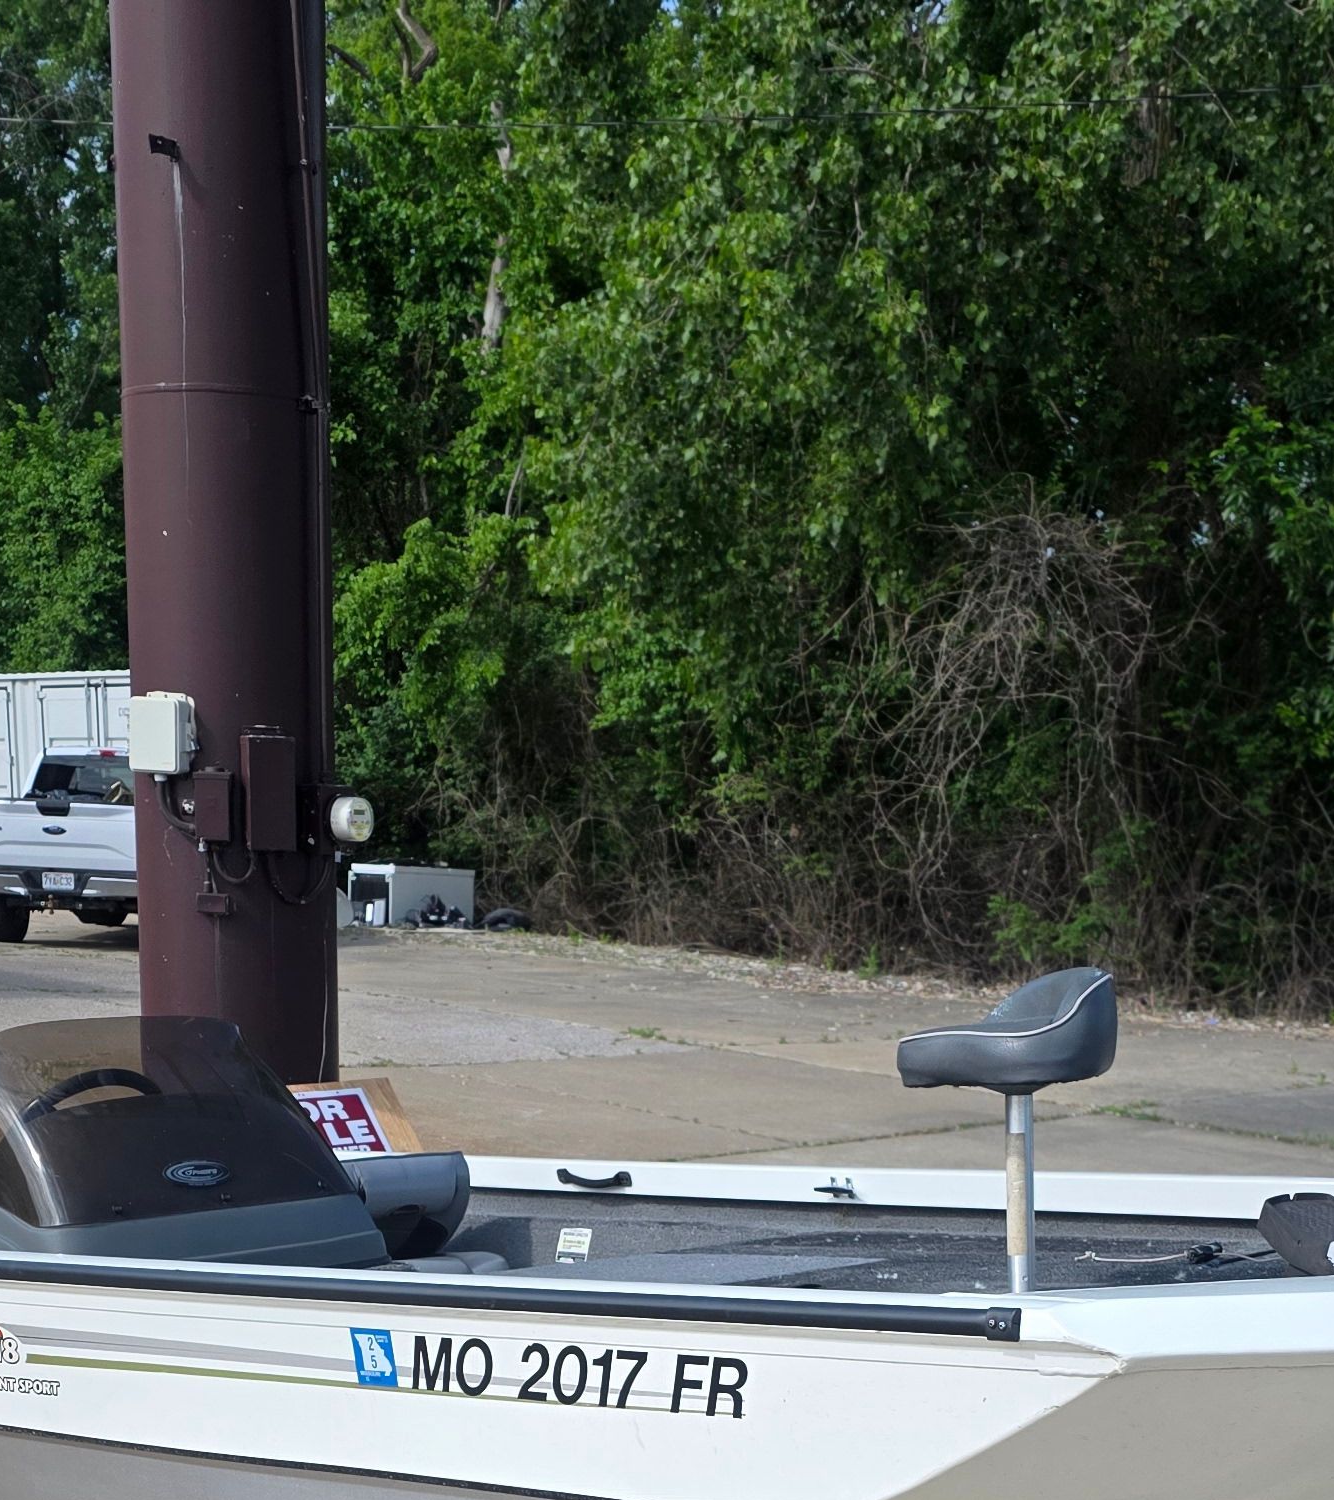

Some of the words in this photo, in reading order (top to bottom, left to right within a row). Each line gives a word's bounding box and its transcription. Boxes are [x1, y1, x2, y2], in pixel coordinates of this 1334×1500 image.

[17, 1378, 61, 1396] SPORT
[412, 1336, 493, 1396] MO
[517, 1342, 648, 1409] 2017
[670, 1353, 749, 1418] FR
